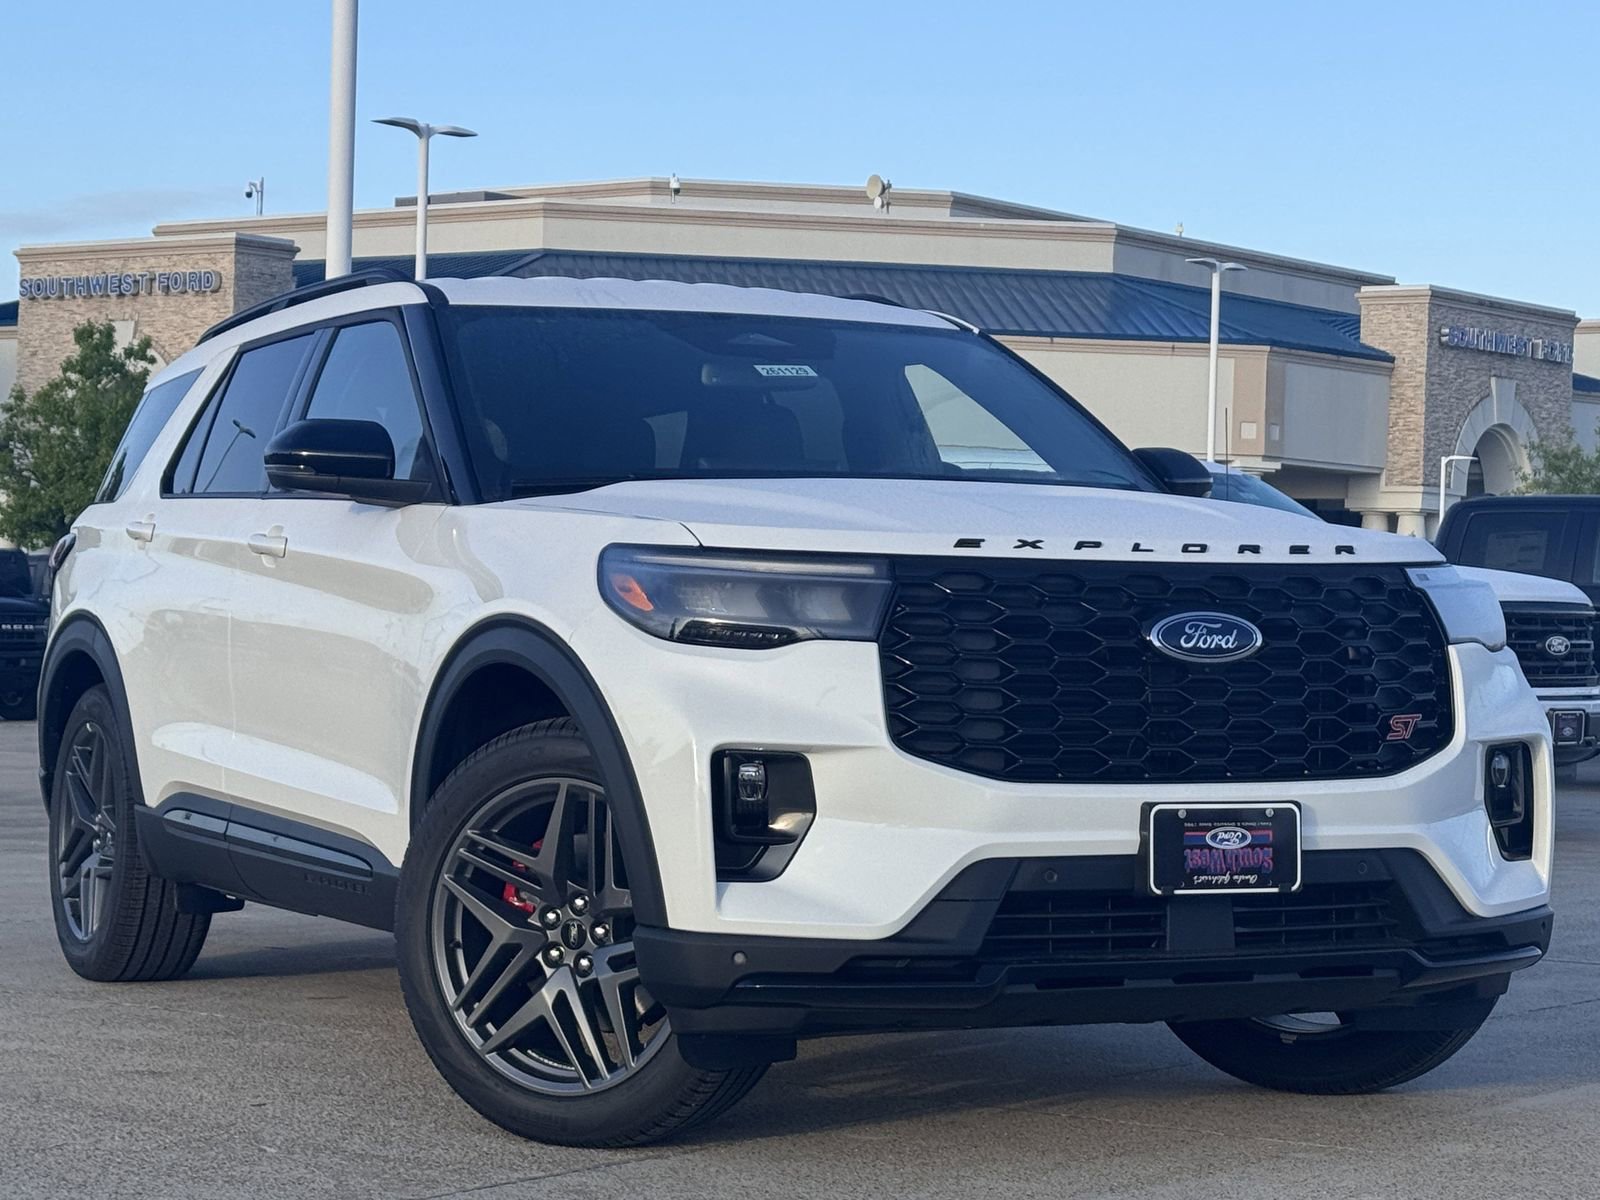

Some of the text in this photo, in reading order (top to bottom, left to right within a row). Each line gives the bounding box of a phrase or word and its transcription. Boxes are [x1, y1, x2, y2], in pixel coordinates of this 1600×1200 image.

[19, 269, 221, 298] SOUTHWEST FORD
[952, 536, 1358, 556] EXPLORER
[1180, 621, 1238, 648] Ford
[1386, 713, 1423, 740] ST
[1216, 831, 1243, 846] Ford
